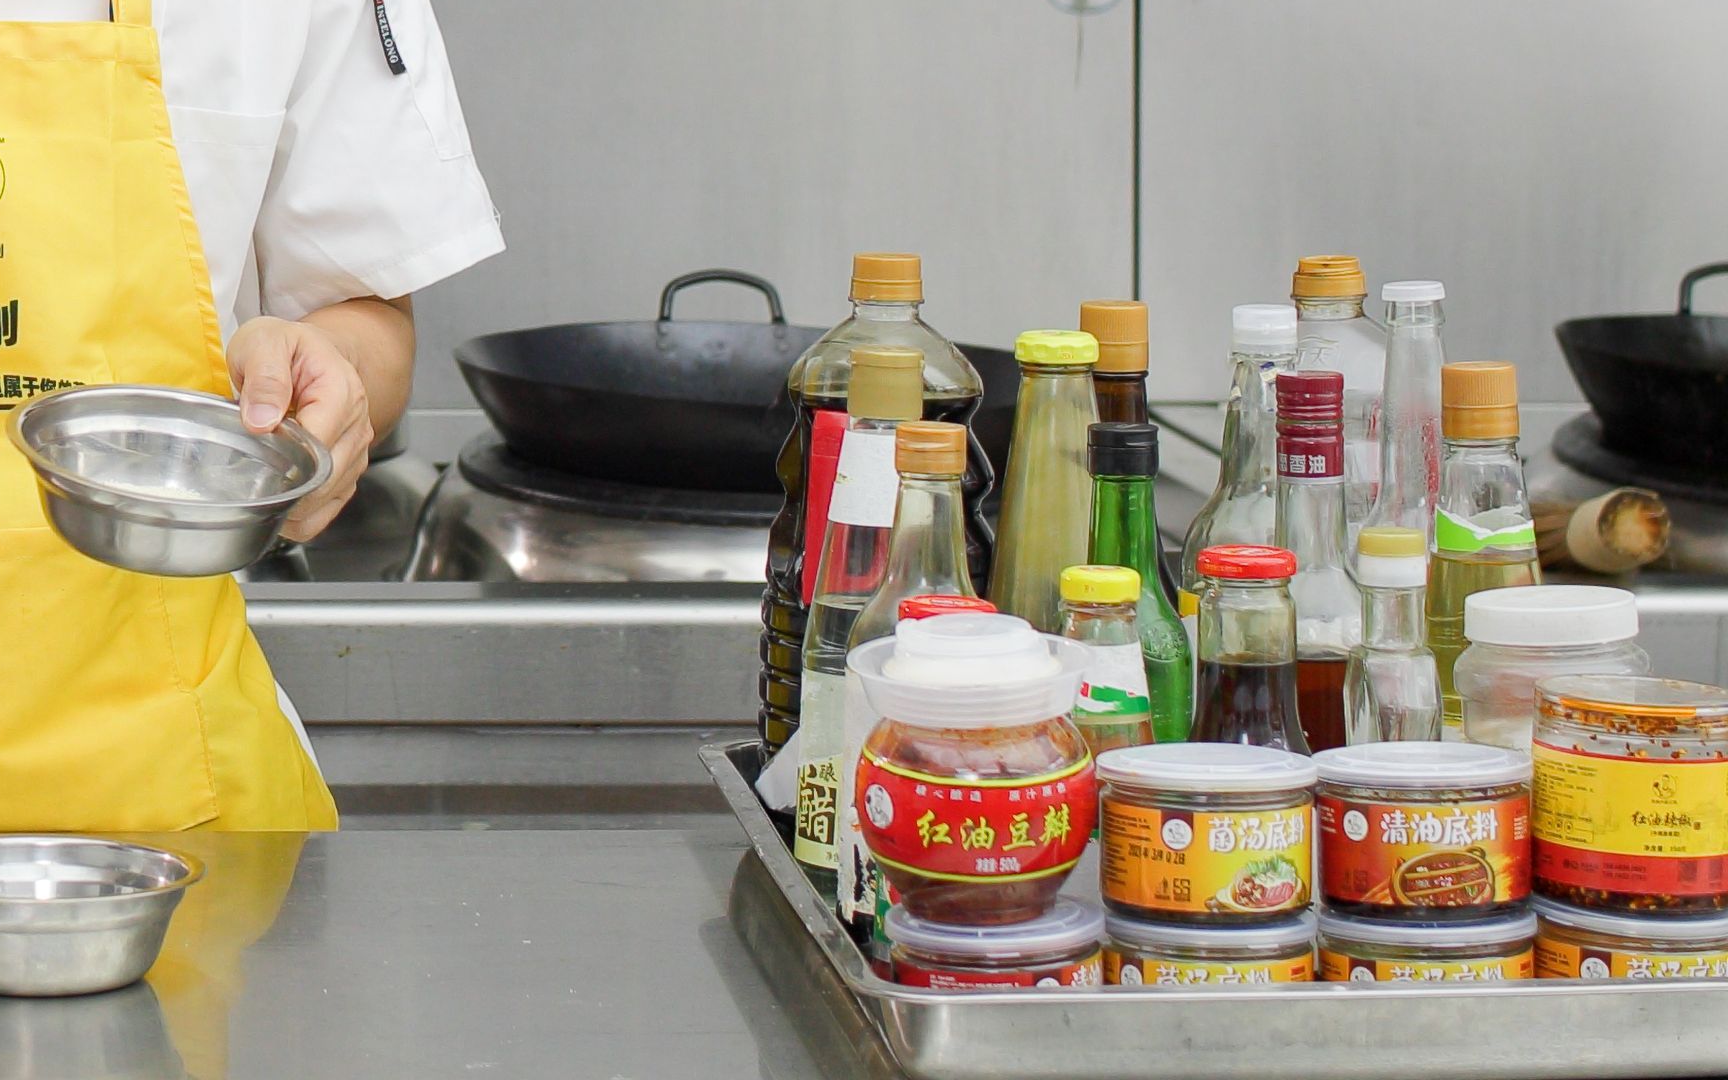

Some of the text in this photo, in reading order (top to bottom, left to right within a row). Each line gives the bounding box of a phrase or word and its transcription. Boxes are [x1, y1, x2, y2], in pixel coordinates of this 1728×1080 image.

[798, 786, 836, 843] 醋
[916, 802, 1072, 852] 红油豆瓣
[1207, 812, 1305, 853] 菌汤底料
[1379, 807, 1499, 845] 清油底料
